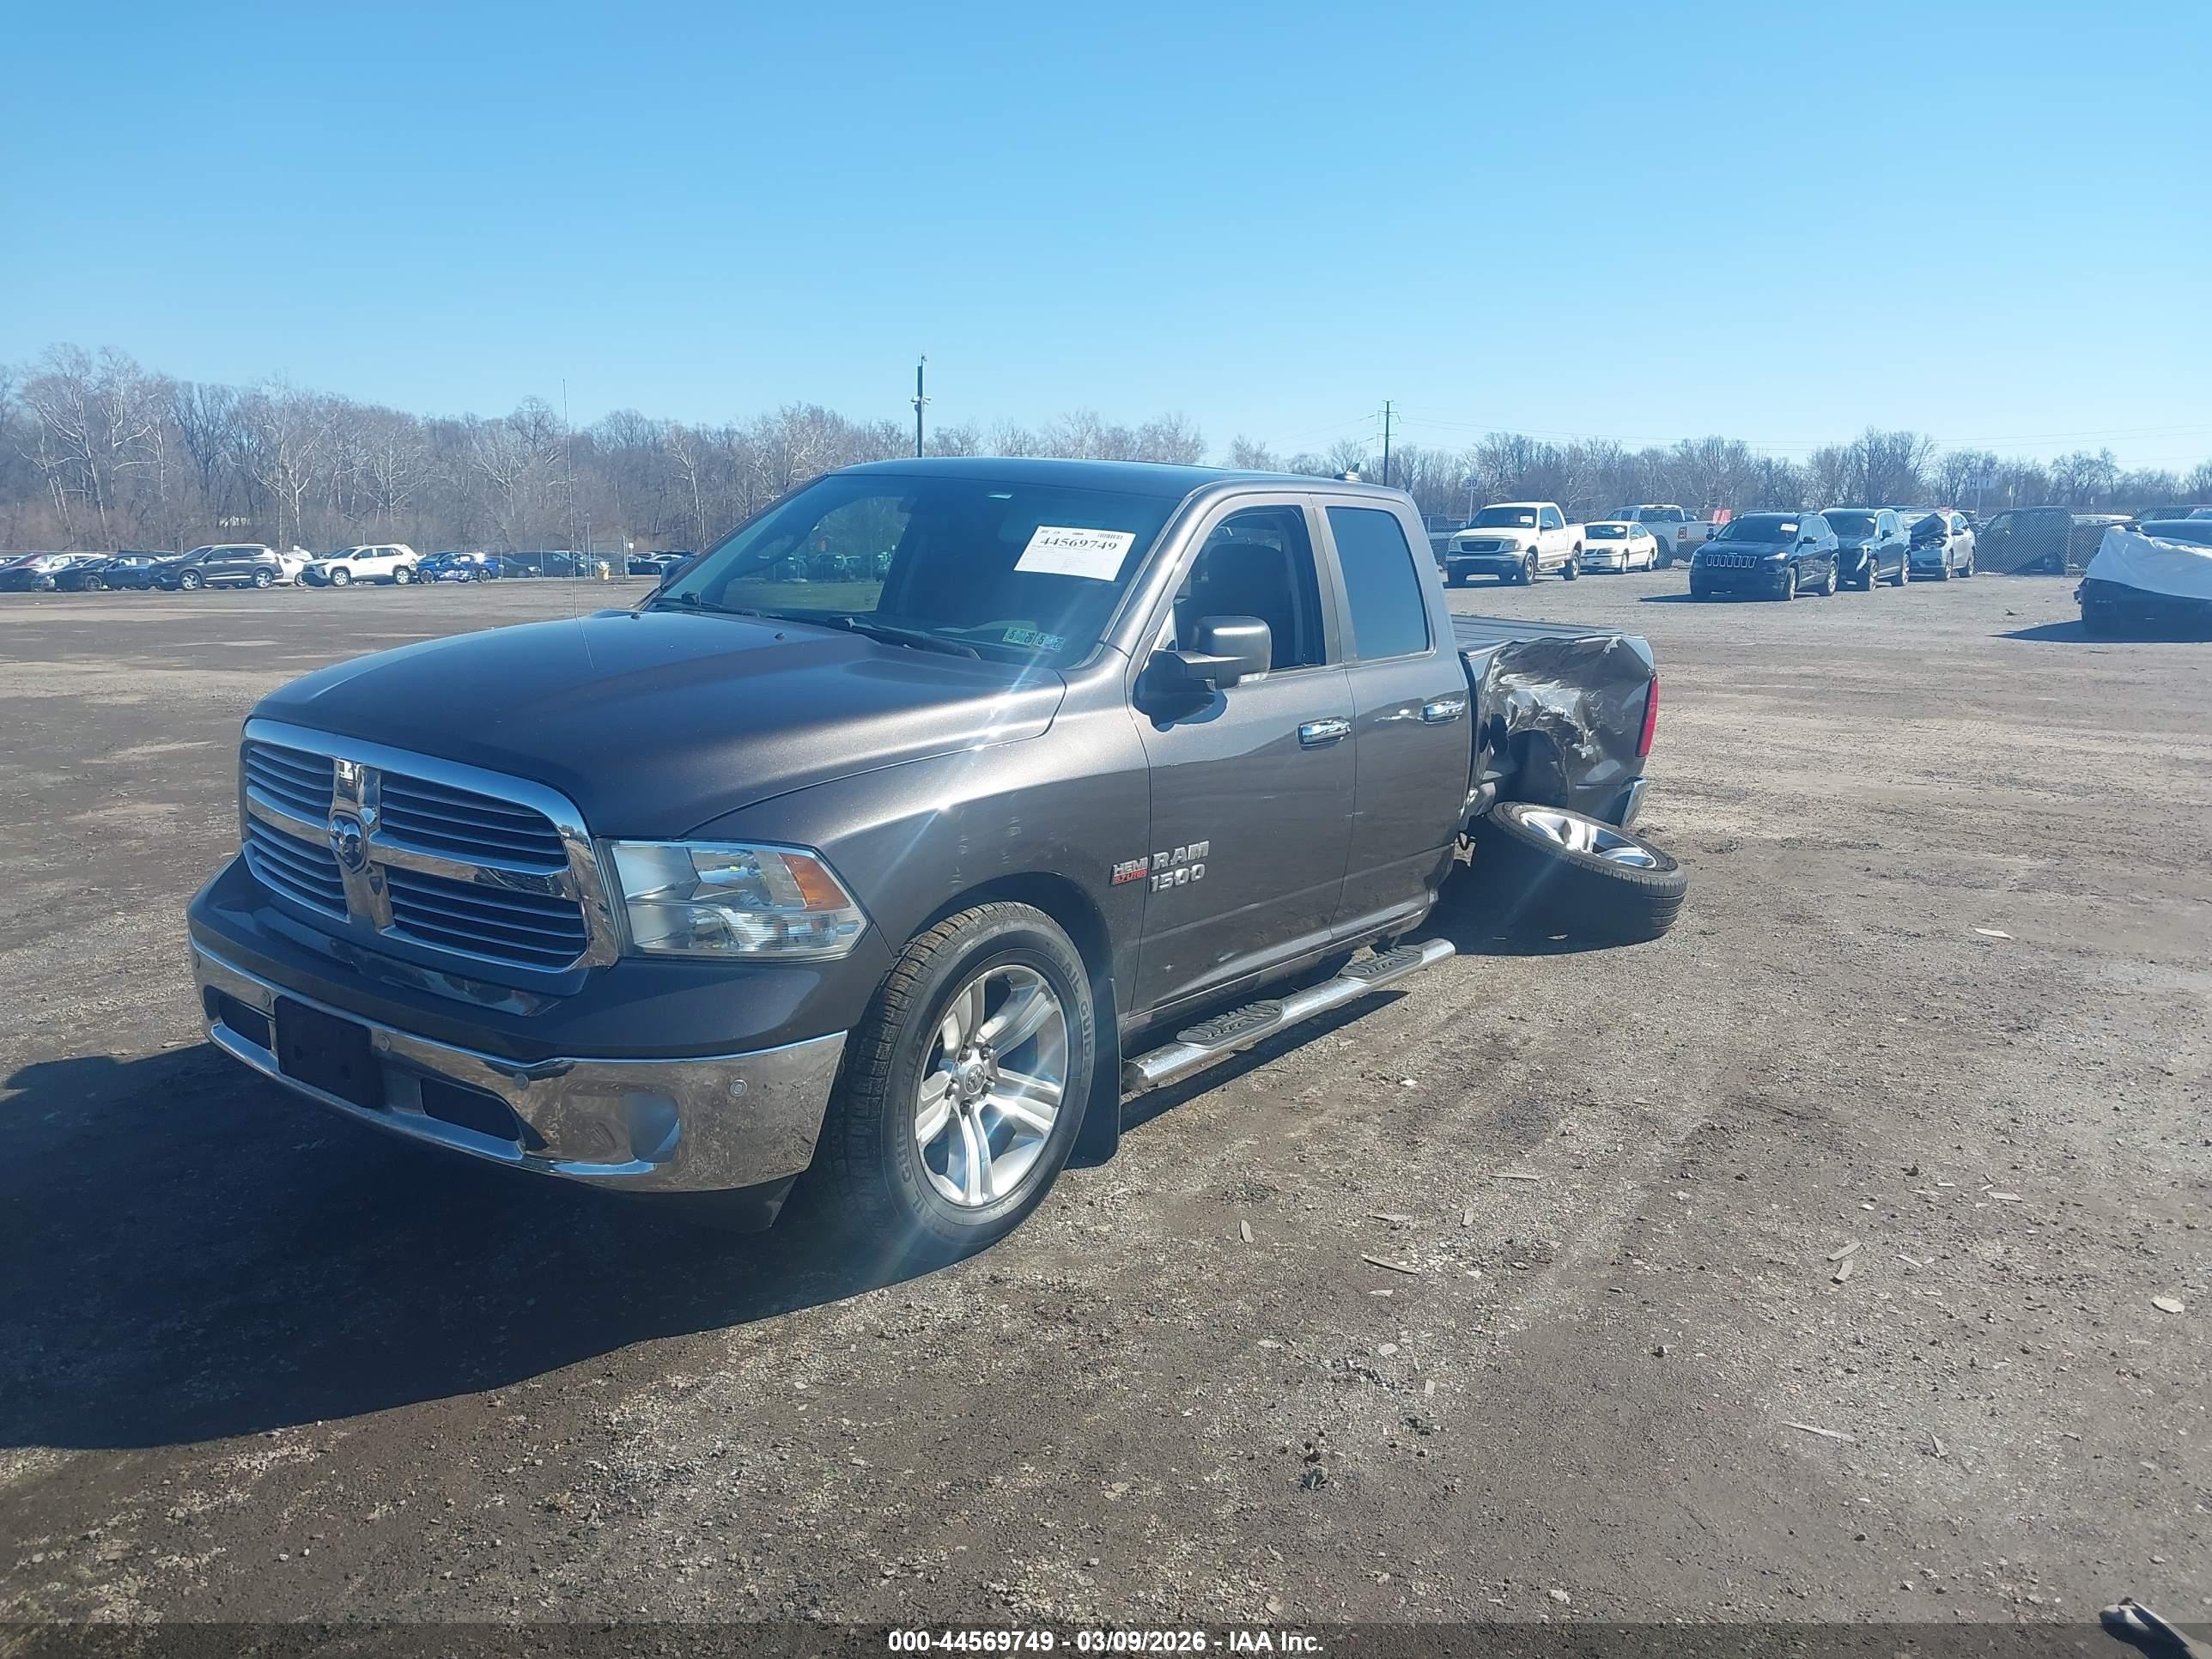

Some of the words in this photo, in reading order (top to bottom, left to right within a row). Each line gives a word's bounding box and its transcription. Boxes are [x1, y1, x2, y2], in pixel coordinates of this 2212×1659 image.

[1040, 537, 1117, 550] 44569749
[1152, 841, 1209, 871] RAM
[1151, 864, 1205, 892] 1500
